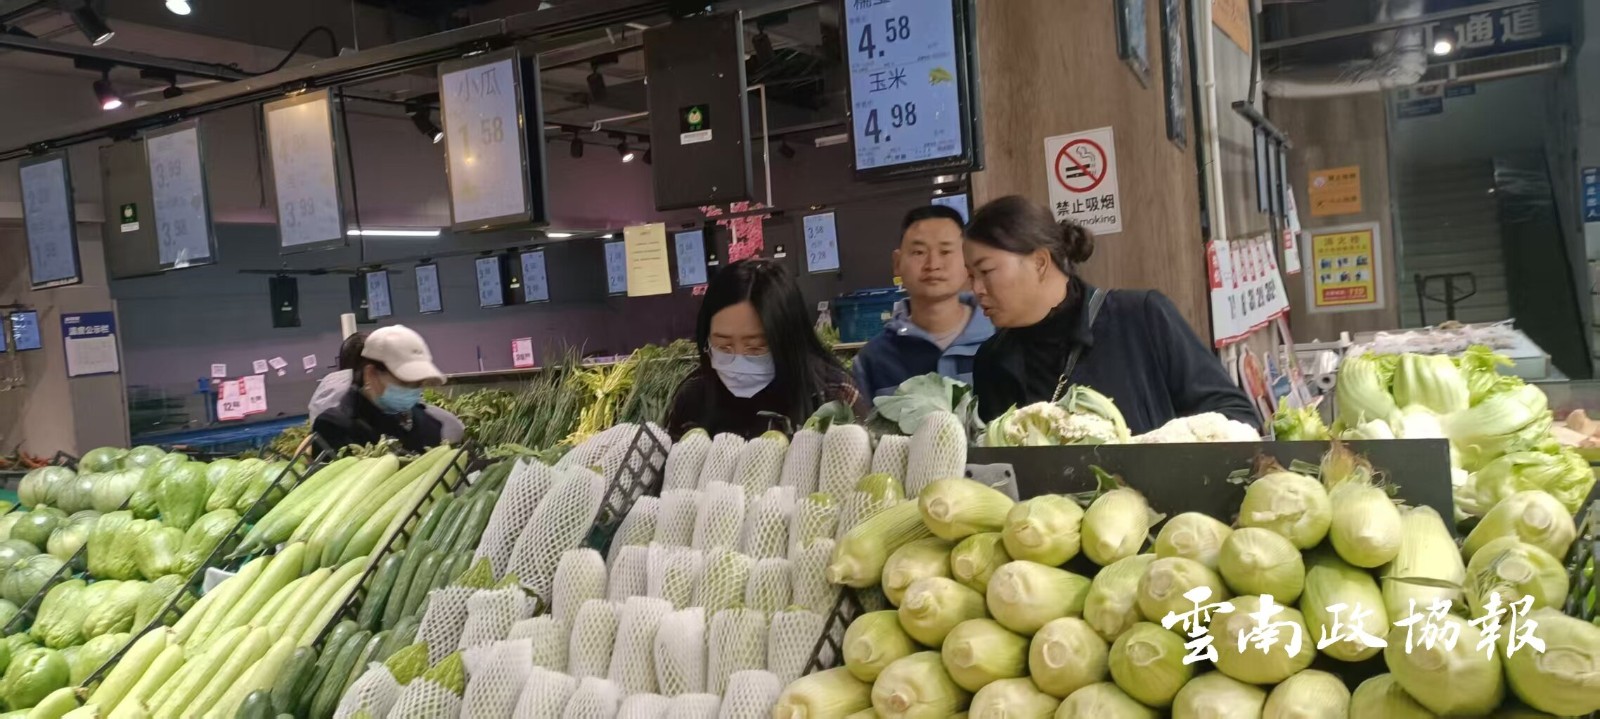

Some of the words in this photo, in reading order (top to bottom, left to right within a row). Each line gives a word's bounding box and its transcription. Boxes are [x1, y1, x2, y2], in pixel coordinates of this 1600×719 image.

[858, 15, 910, 59] 4.58
[457, 67, 501, 101] 小瓜
[869, 67, 907, 93] 玉米
[864, 102, 917, 144] 4.98
[1056, 194, 1114, 217] 禁止吸烟
